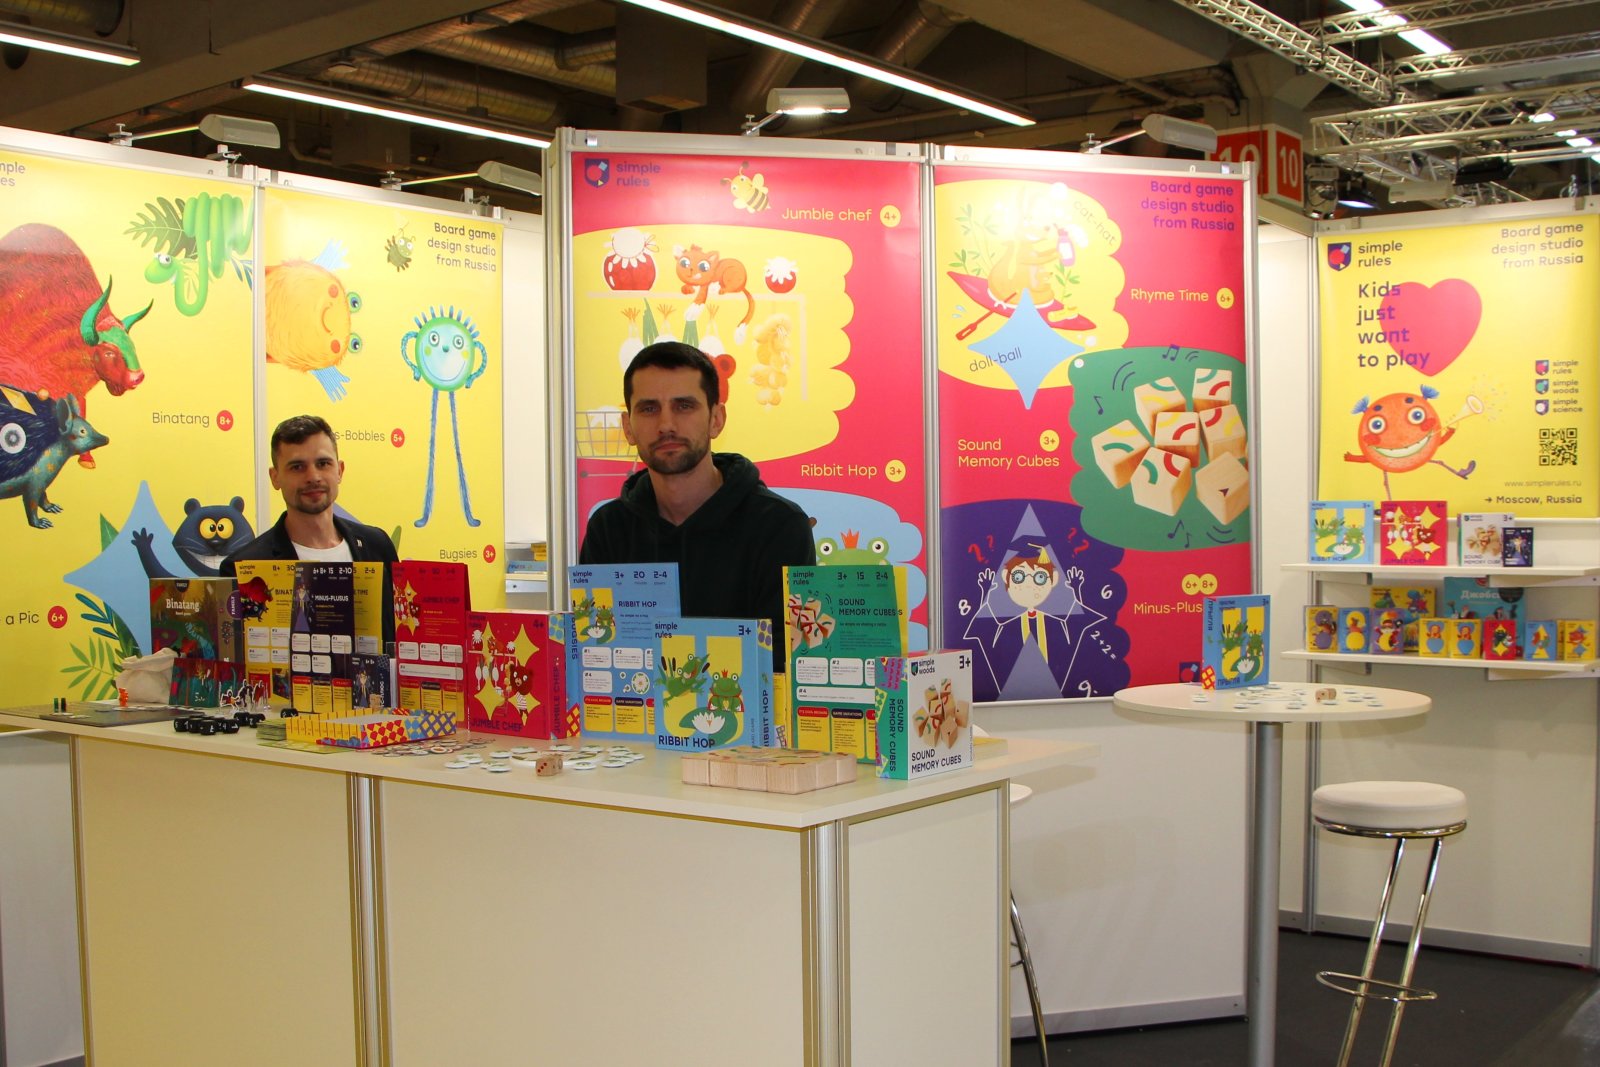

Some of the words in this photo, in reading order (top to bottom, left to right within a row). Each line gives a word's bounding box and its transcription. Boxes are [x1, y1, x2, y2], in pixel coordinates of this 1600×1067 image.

[616, 161, 661, 175] simple
[1279, 146, 1298, 188] 10
[616, 175, 650, 187] rules
[1151, 181, 1191, 193] Board
[1196, 185, 1233, 198] game
[1141, 197, 1187, 214] design
[1191, 200, 1234, 213] studio
[782, 208, 834, 220] Jumble
[839, 208, 872, 221] chef
[884, 212, 896, 220] 4+
[1153, 215, 1187, 228] from
[1191, 218, 1234, 231] Russia
[434, 222, 465, 236] Board
[468, 229, 496, 240] game
[1501, 225, 1540, 238] Board
[1545, 224, 1583, 238] game
[428, 237, 461, 253] design
[465, 244, 496, 256] studio
[1358, 240, 1403, 254] simple
[1491, 242, 1535, 255] design
[1540, 237, 1583, 251] studio
[436, 254, 461, 267] from
[465, 258, 496, 272] Russia
[1358, 256, 1391, 268] rules
[1503, 258, 1535, 269] from
[1539, 253, 1583, 266] Russia
[1131, 288, 1175, 303] Rhyme
[1178, 289, 1209, 302] Time
[1220, 294, 1231, 302] 6+
[1358, 281, 1401, 298] Kids
[1356, 305, 1395, 326] just
[1358, 328, 1410, 344] want
[969, 347, 1022, 372] doll-ball
[1358, 353, 1379, 367] to
[1386, 349, 1430, 371] play
[1552, 379, 1579, 387] simple
[1552, 398, 1578, 406] simple
[152, 412, 210, 428] Binatang
[219, 416, 231, 425] 8+
[393, 434, 403, 442] 5+
[958, 438, 1002, 451] Sound
[1043, 436, 1056, 445] 3+
[958, 455, 1013, 470] Memory
[1016, 455, 1060, 467] Cubes
[801, 464, 843, 476] Ribbit
[848, 464, 877, 479] Hop
[889, 466, 902, 476] 3+
[1496, 496, 1543, 505] Moscow,
[1546, 494, 1582, 504] Russia
[440, 548, 478, 561] Bugsies
[485, 550, 494, 558] 3+
[572, 570, 592, 579] simple
[615, 571, 624, 579] 3+
[633, 571, 645, 579] 20
[653, 571, 667, 579] 2-4
[793, 570, 814, 579] simple
[838, 572, 848, 580] 3+
[857, 572, 865, 580] 15
[876, 572, 889, 580] 2-4
[1186, 581, 1197, 589] 6+
[1202, 580, 1214, 589] 8+
[165, 598, 200, 613] Binatang
[958, 599, 972, 616] 8
[5, 614, 15, 625] a
[19, 611, 40, 624] Pic
[51, 612, 65, 622] 6+
[655, 621, 678, 631] simple
[738, 625, 752, 636] 3+
[655, 631, 673, 639] rules
[919, 658, 935, 669] simple
[959, 655, 971, 669] 3+
[919, 665, 936, 674] woods
[472, 717, 500, 730] JUMBLE
[503, 720, 523, 732] CHEF
[889, 699, 897, 739] MEMORY
[658, 735, 690, 747] RIBBIT
[693, 738, 716, 749] HOP
[911, 749, 936, 762] SOUND
[911, 760, 940, 774] MEMORY
[941, 755, 962, 768] CUBES
